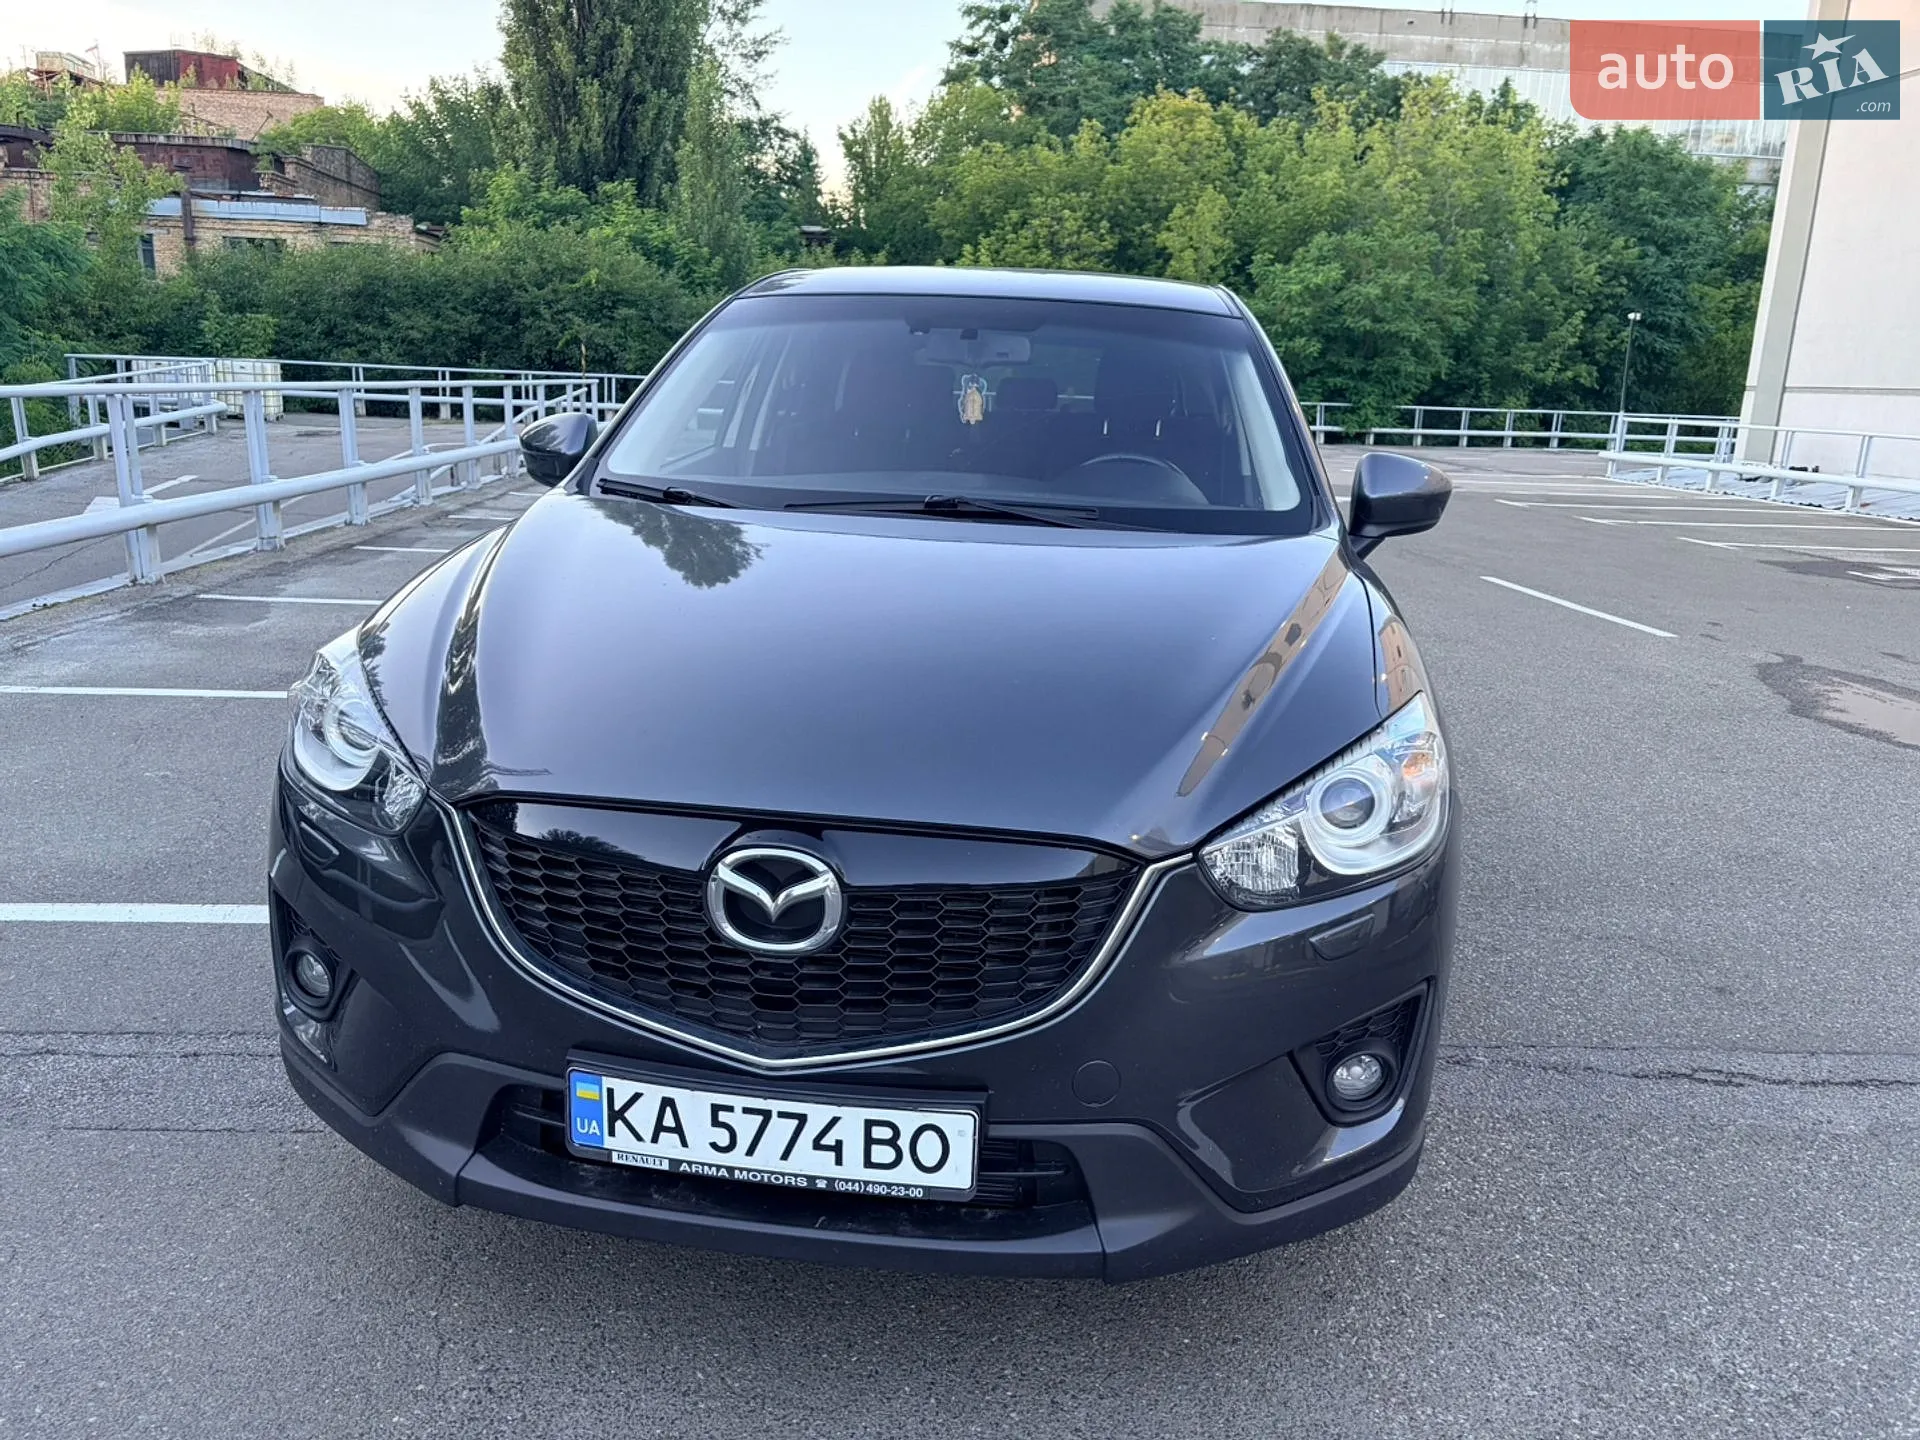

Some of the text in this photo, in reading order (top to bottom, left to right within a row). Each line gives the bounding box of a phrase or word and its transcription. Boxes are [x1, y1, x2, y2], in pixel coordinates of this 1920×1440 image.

[576, 1117, 600, 1136] UA
[606, 1087, 950, 1175] KA 5774 BO
[617, 1153, 664, 1167] RENAULT
[679, 1162, 729, 1178] ARMA
[734, 1169, 808, 1187] MOTORS
